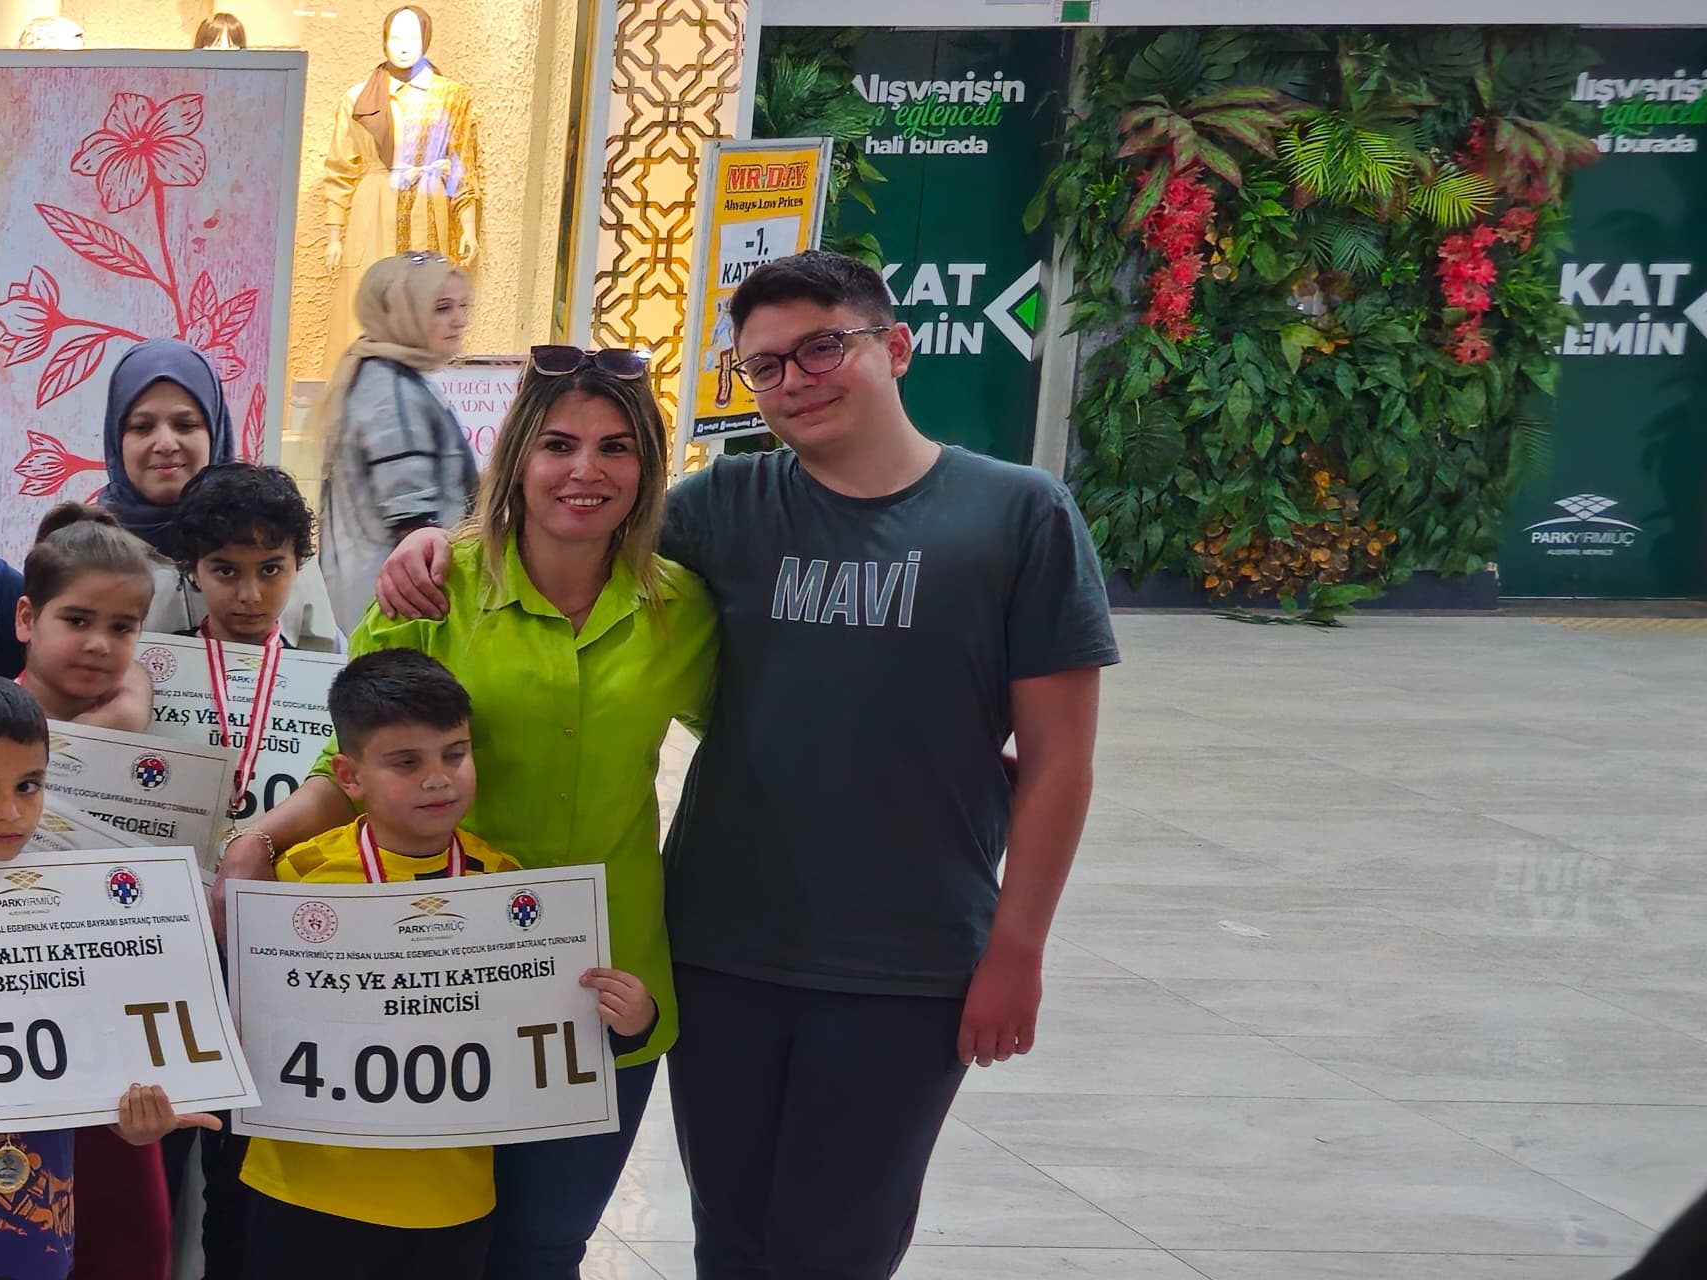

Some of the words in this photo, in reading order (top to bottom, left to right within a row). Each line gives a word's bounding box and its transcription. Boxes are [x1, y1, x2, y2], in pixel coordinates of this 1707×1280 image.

[866, 135, 904, 153] hali
[910, 136, 988, 154] burada
[724, 200, 756, 212] Always
[757, 199, 776, 209] Low
[778, 196, 803, 208] Prices
[1560, 264, 1691, 306] KAT
[772, 550, 921, 628] MAVİ
[154, 706, 190, 727] YAŞ
[195, 709, 220, 725] VE
[47, 935, 163, 961] KATEGORİSİ
[287, 969, 300, 987] 8
[304, 969, 351, 994] YAŞ
[355, 972, 386, 990] VE
[391, 971, 439, 990] ALTI
[446, 956, 555, 988] KATEGORİSİ
[384, 991, 480, 1016] BİRİNCİSİ
[125, 1000, 222, 1067] TL
[280, 1041, 491, 1104] 4.000
[517, 1021, 596, 1089] TL
